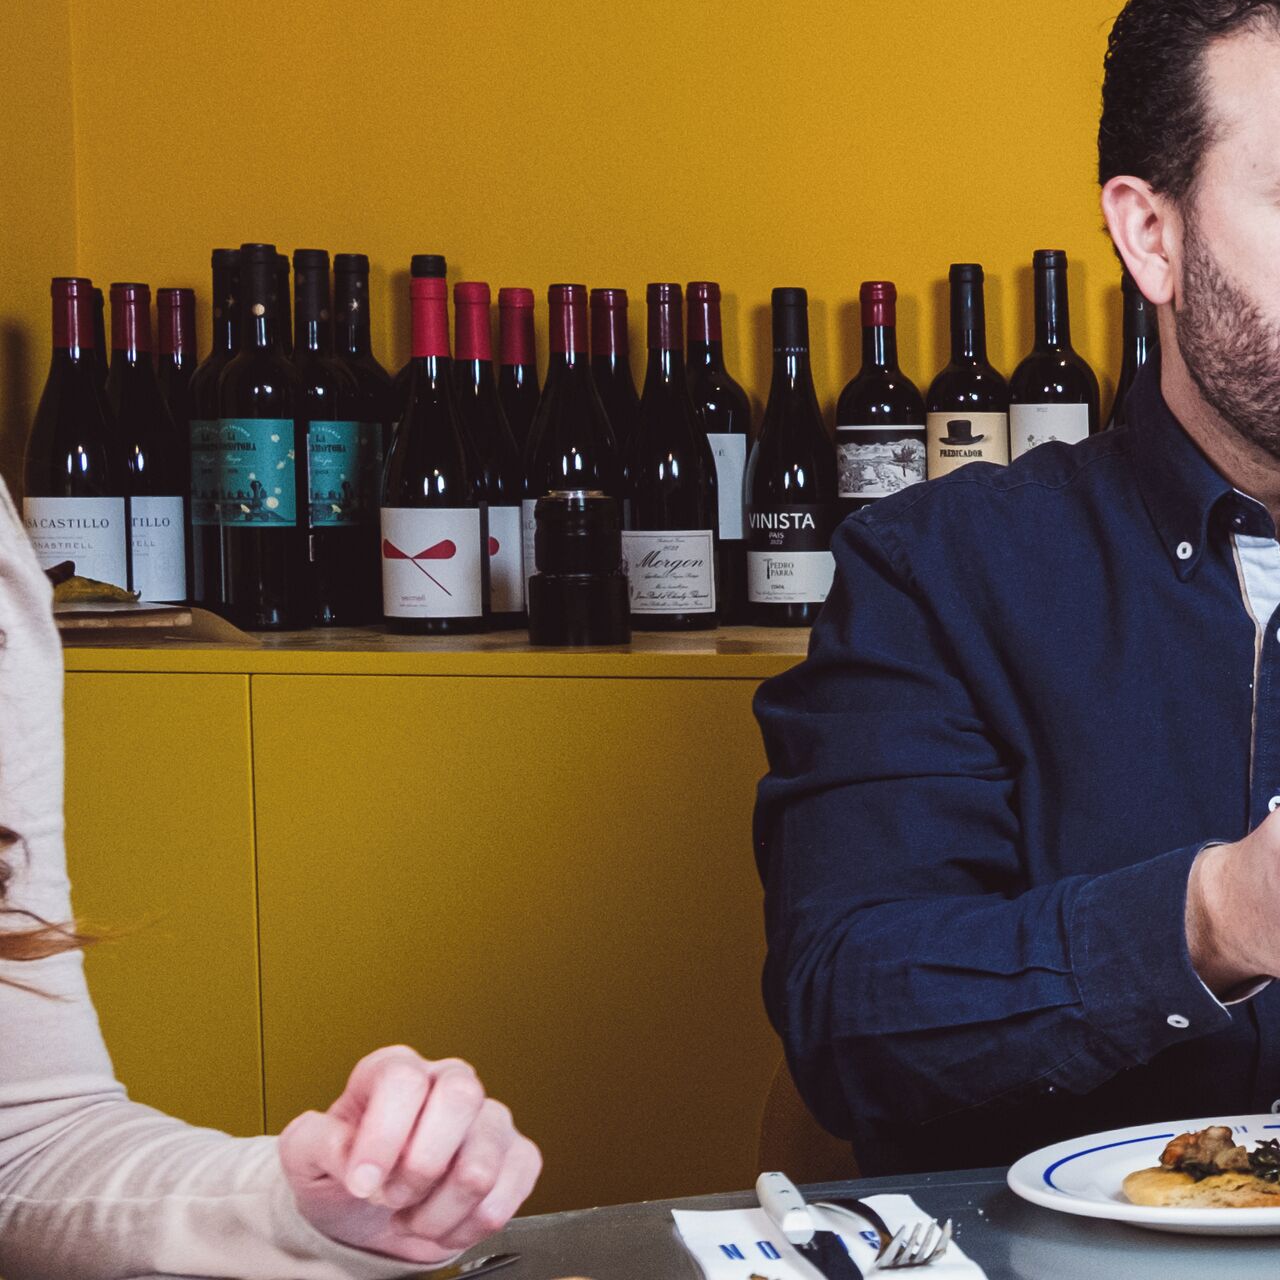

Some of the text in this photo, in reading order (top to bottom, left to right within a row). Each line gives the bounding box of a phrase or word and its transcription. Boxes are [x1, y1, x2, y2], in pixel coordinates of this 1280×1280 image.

[939, 449, 983, 457] PREDICADOR
[40, 518, 110, 529] CASTILLO
[748, 513, 816, 530] VINISTA
[635, 550, 705, 576] Morgon
[770, 569, 794, 577] PARRA
